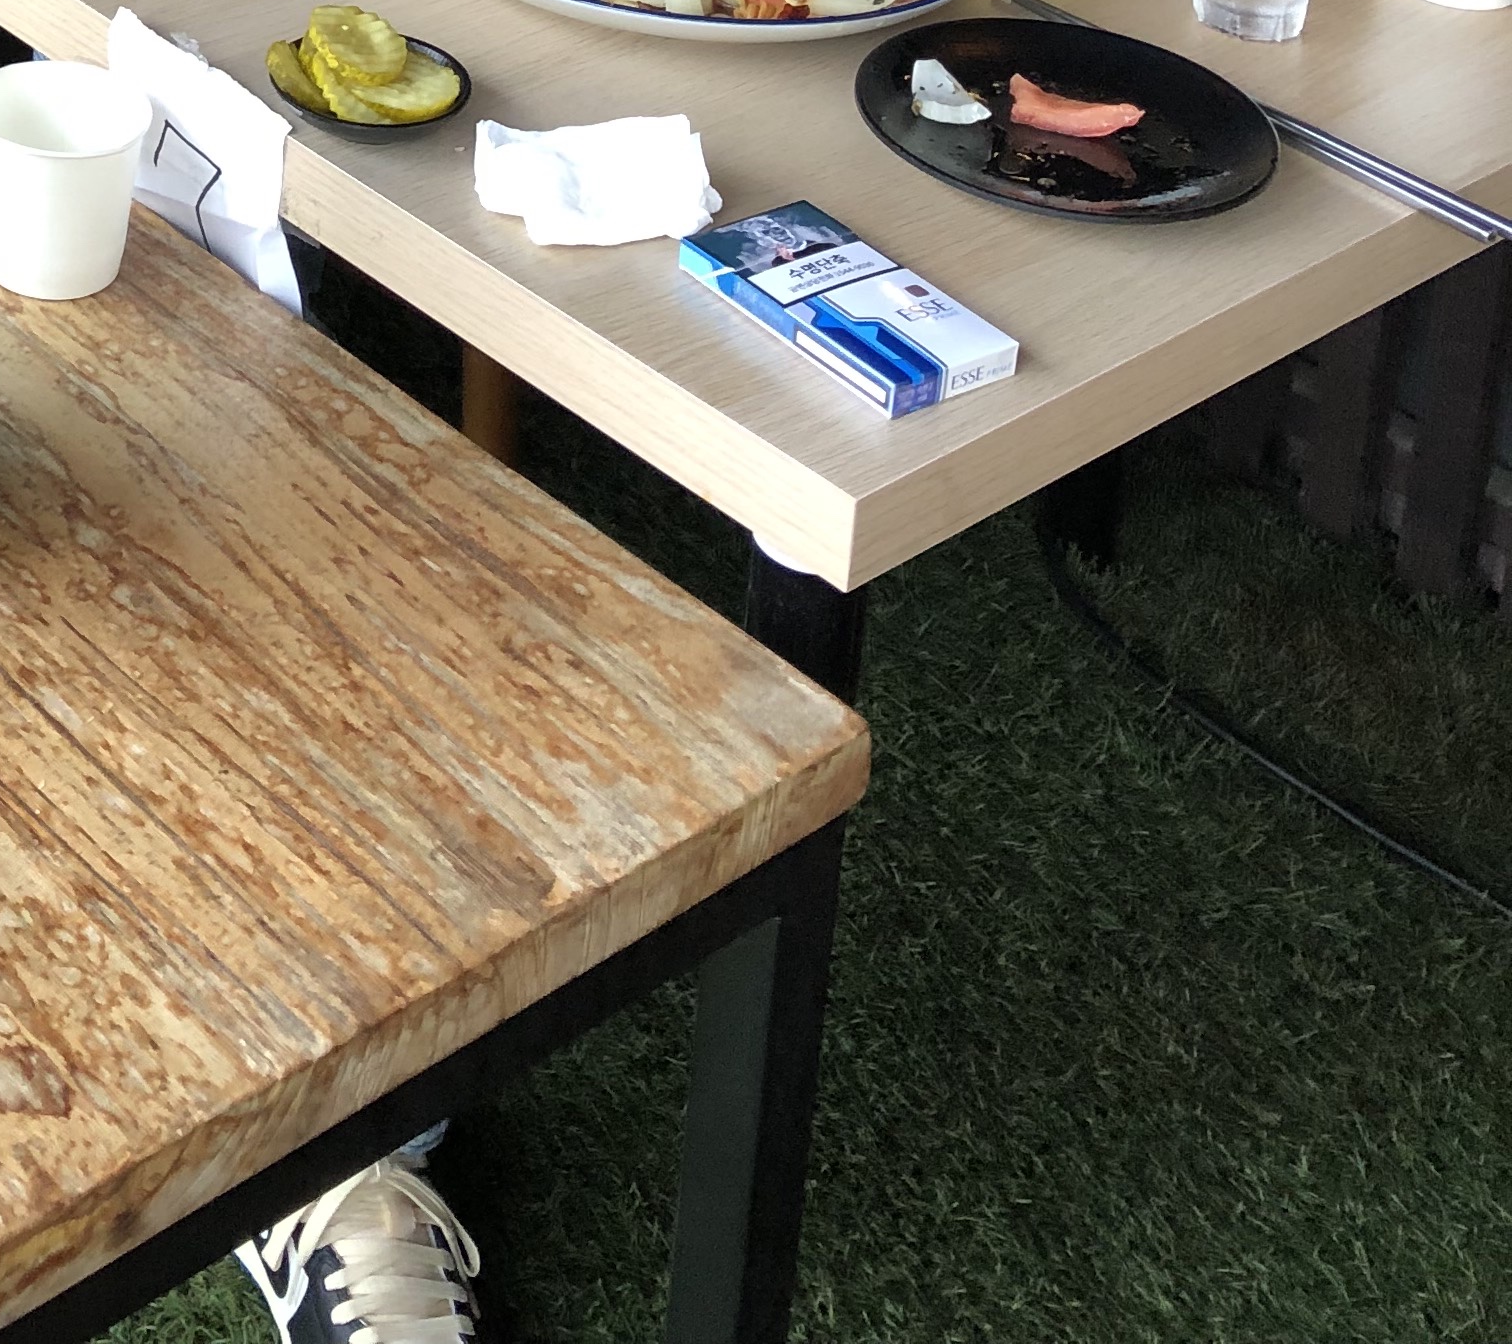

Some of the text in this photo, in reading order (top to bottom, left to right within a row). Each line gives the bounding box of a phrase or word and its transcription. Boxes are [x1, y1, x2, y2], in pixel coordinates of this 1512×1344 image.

[788, 254, 851, 279] 수명단축
[895, 298, 954, 323] ESSE
[950, 365, 986, 391] ESSE
